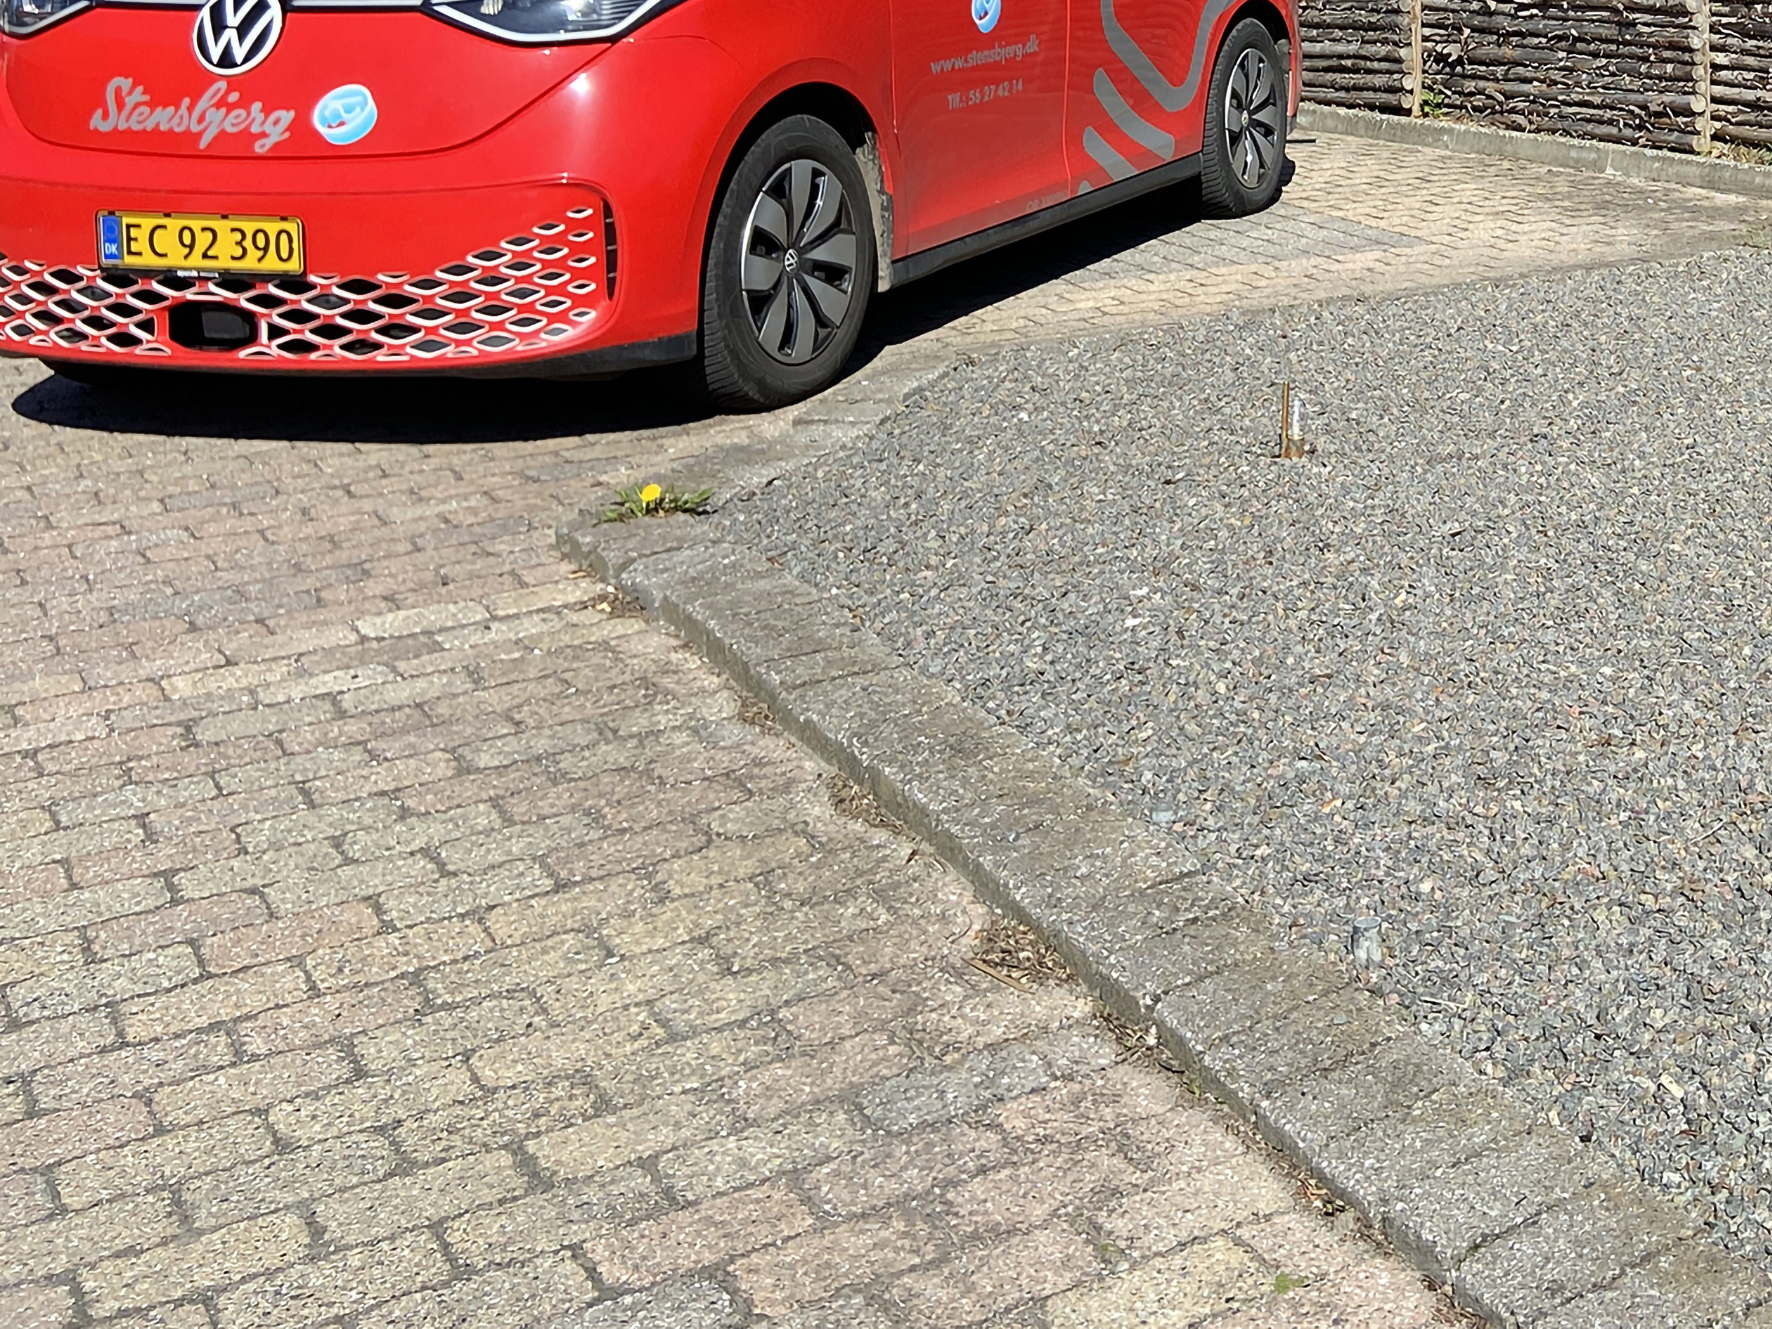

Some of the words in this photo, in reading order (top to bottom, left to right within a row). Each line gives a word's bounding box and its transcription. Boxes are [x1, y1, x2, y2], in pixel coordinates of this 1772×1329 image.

[90, 76, 295, 153] Stensbjerg
[104, 242, 119, 255] DK
[126, 223, 168, 258] EC
[178, 225, 219, 261] 92
[230, 227, 295, 263] 390
